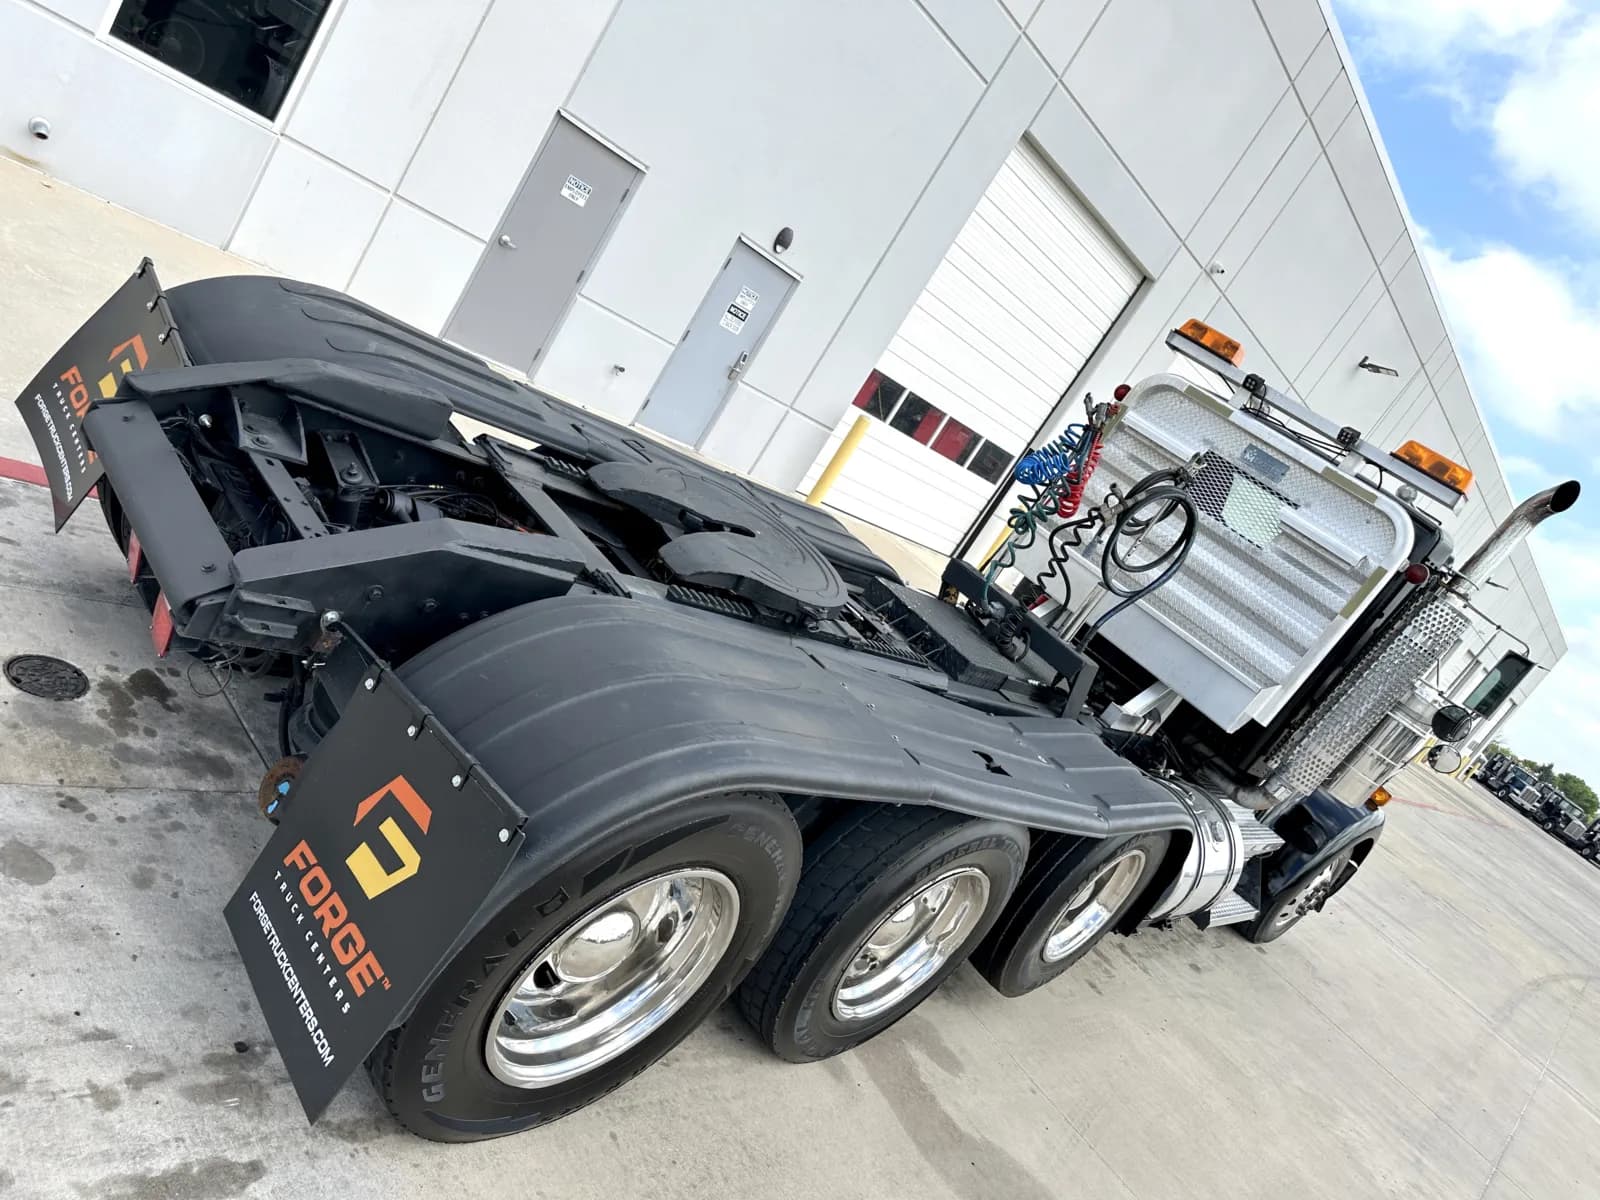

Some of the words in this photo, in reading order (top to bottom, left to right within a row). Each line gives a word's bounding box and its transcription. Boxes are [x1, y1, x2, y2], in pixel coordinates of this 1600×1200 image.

[52, 382, 71, 420] TRUCK
[69, 423, 87, 474] CENTERS
[249, 891, 335, 1068] FORGETRUCKCENTERS.COM
[274, 870, 305, 925] TRUCK
[305, 930, 351, 1014] CENTERS
[421, 927, 535, 1102] GENERAL
